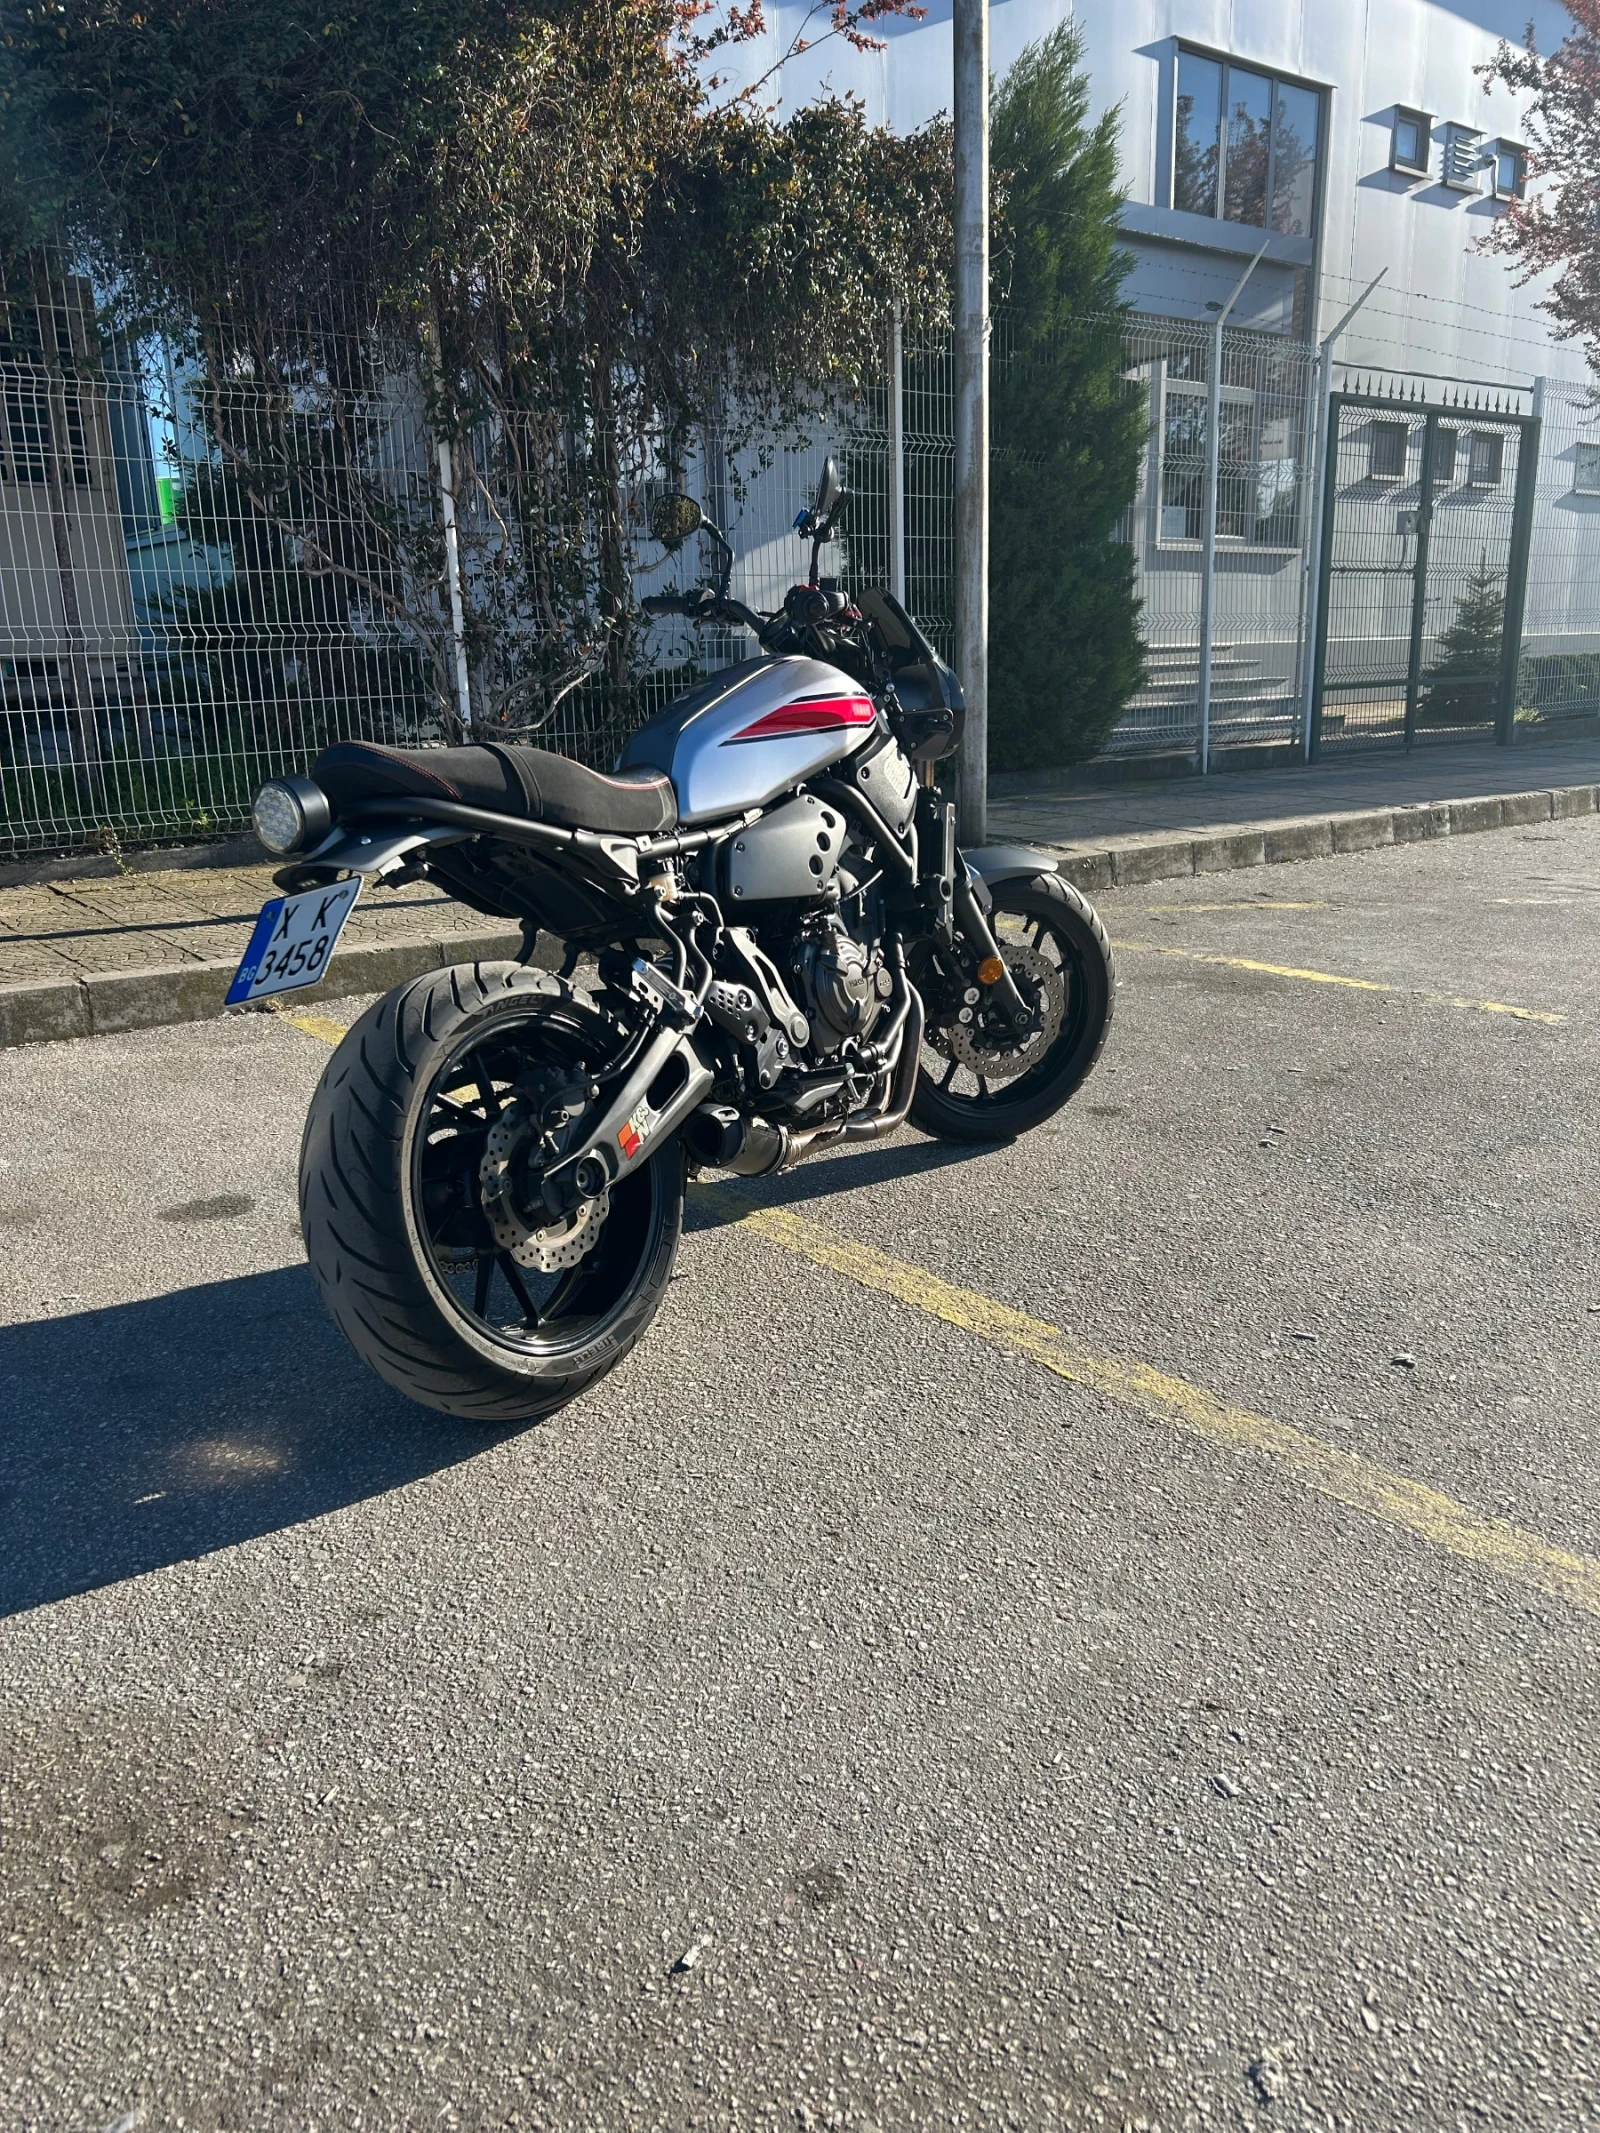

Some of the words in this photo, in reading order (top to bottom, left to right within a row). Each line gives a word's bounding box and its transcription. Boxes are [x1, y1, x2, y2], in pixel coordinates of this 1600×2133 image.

[272, 904, 300, 942] X
[311, 894, 340, 932] K
[237, 965, 258, 984] BG
[254, 935, 330, 985] 3458
[573, 1334, 620, 1369] PIRELLI
